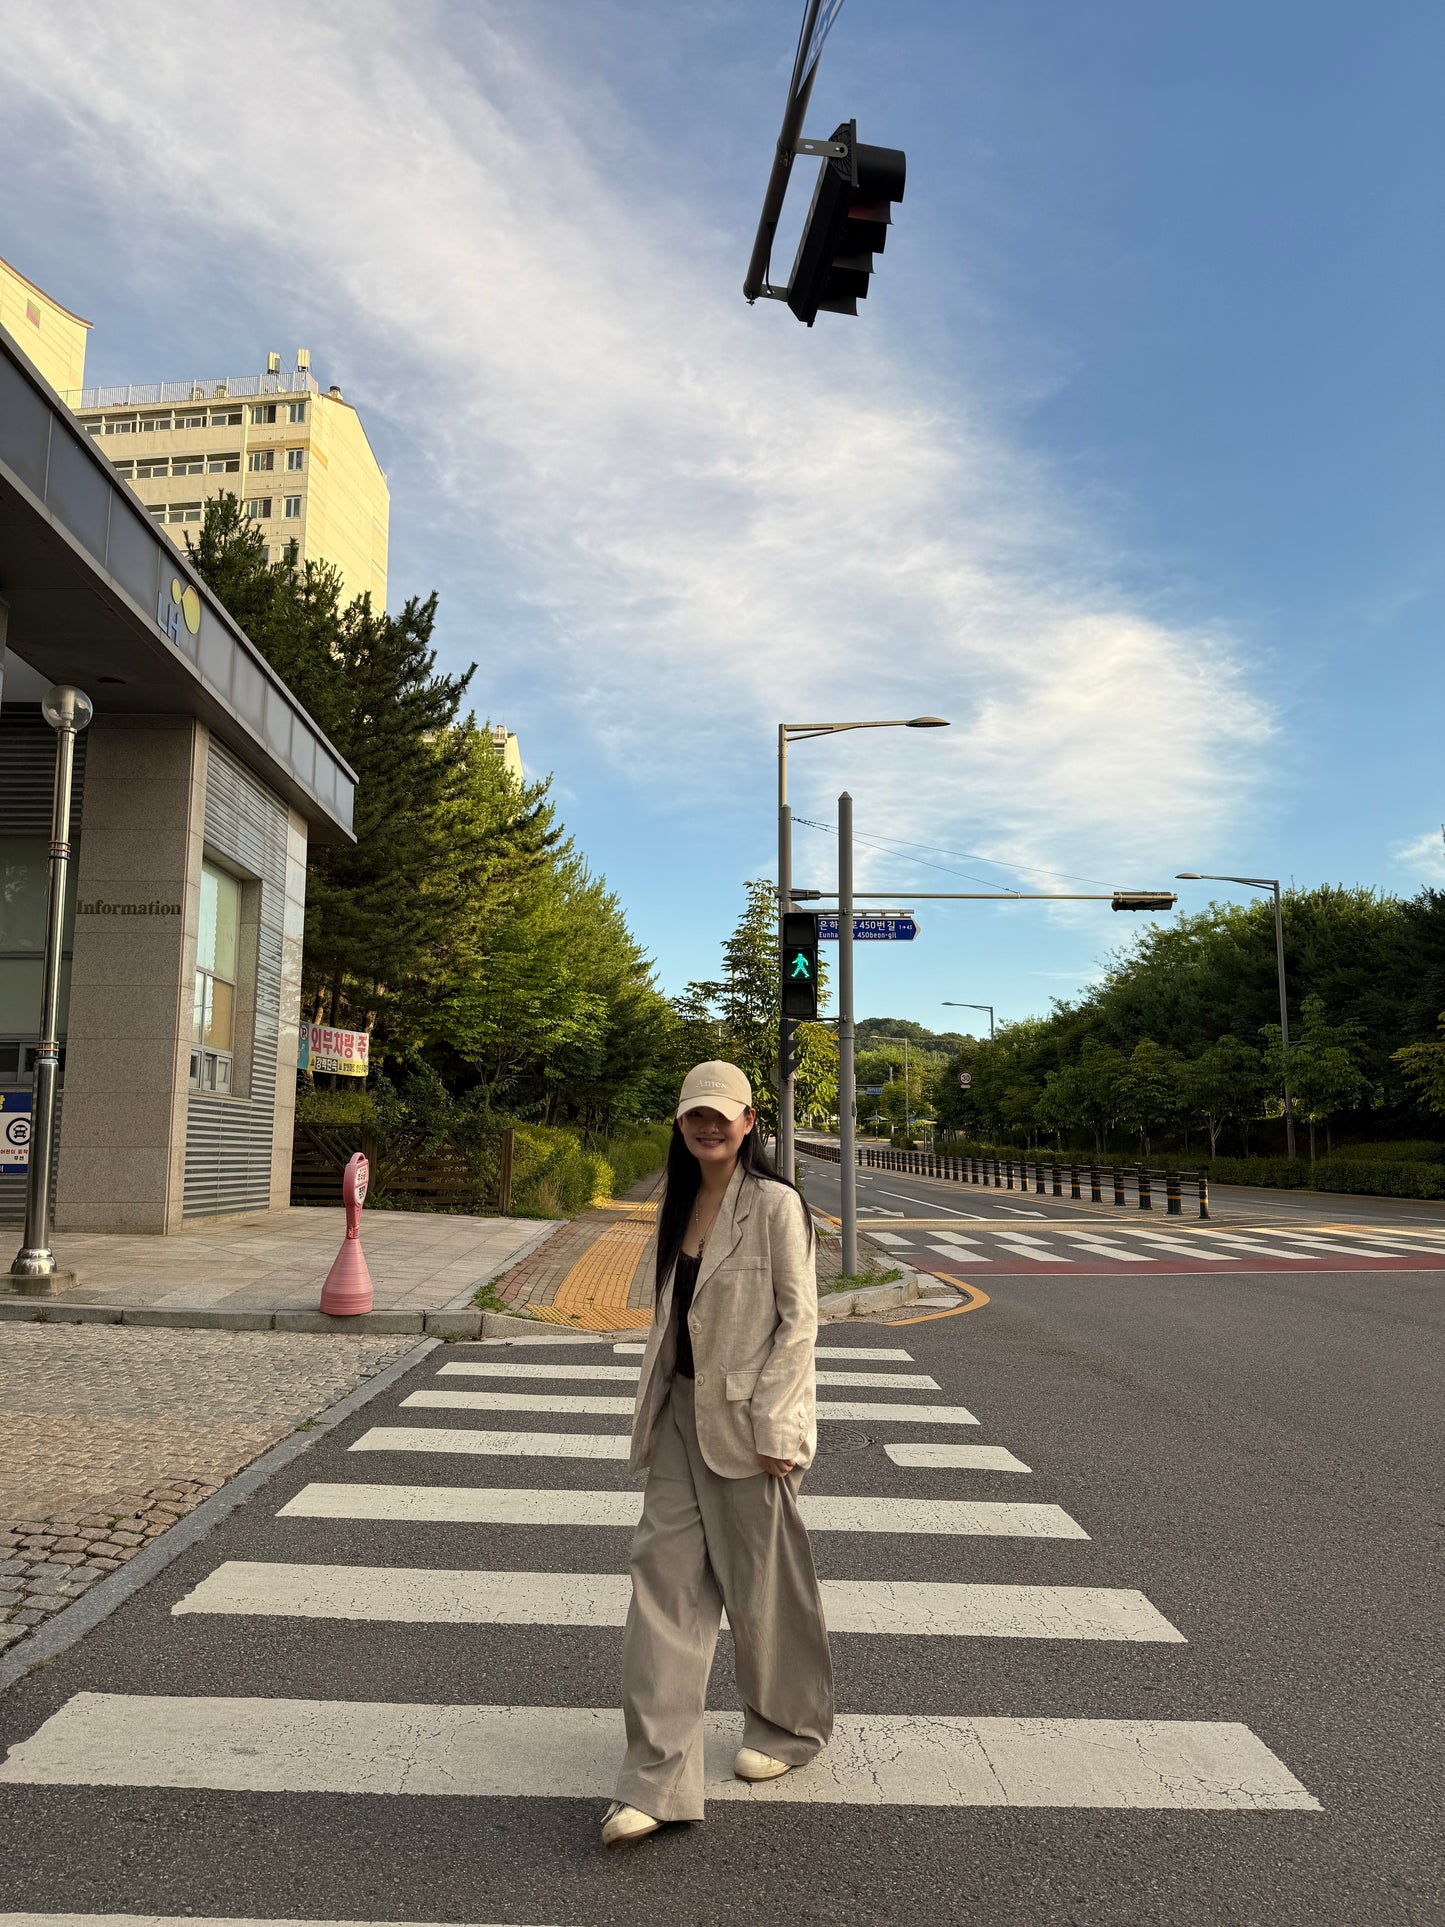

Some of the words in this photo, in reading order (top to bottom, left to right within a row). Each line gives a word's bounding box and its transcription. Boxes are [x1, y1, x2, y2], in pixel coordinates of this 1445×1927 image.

[157, 591, 180, 647] LH
[76, 900, 182, 915] Information
[819, 920, 896, 932] 은하로450번길
[857, 931, 897, 940] 450beon-gil
[311, 1027, 355, 1059] 외부차량
[357, 1035, 368, 1060] 주
